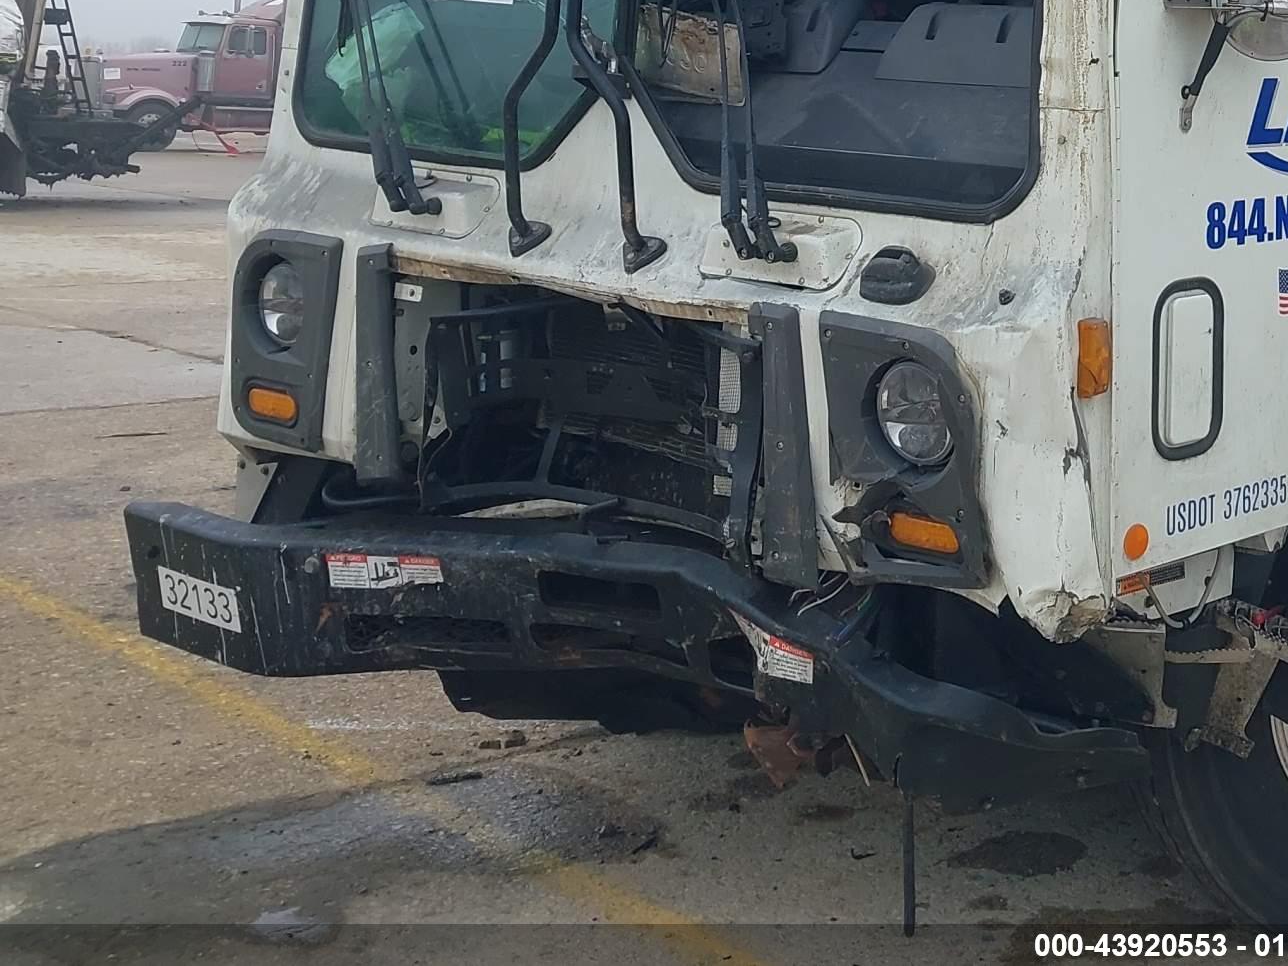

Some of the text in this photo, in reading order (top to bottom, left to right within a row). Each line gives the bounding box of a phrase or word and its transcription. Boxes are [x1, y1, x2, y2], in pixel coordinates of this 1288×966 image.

[1166, 475, 1287, 536] USDOT 3762335
[164, 574, 233, 624] 32133
